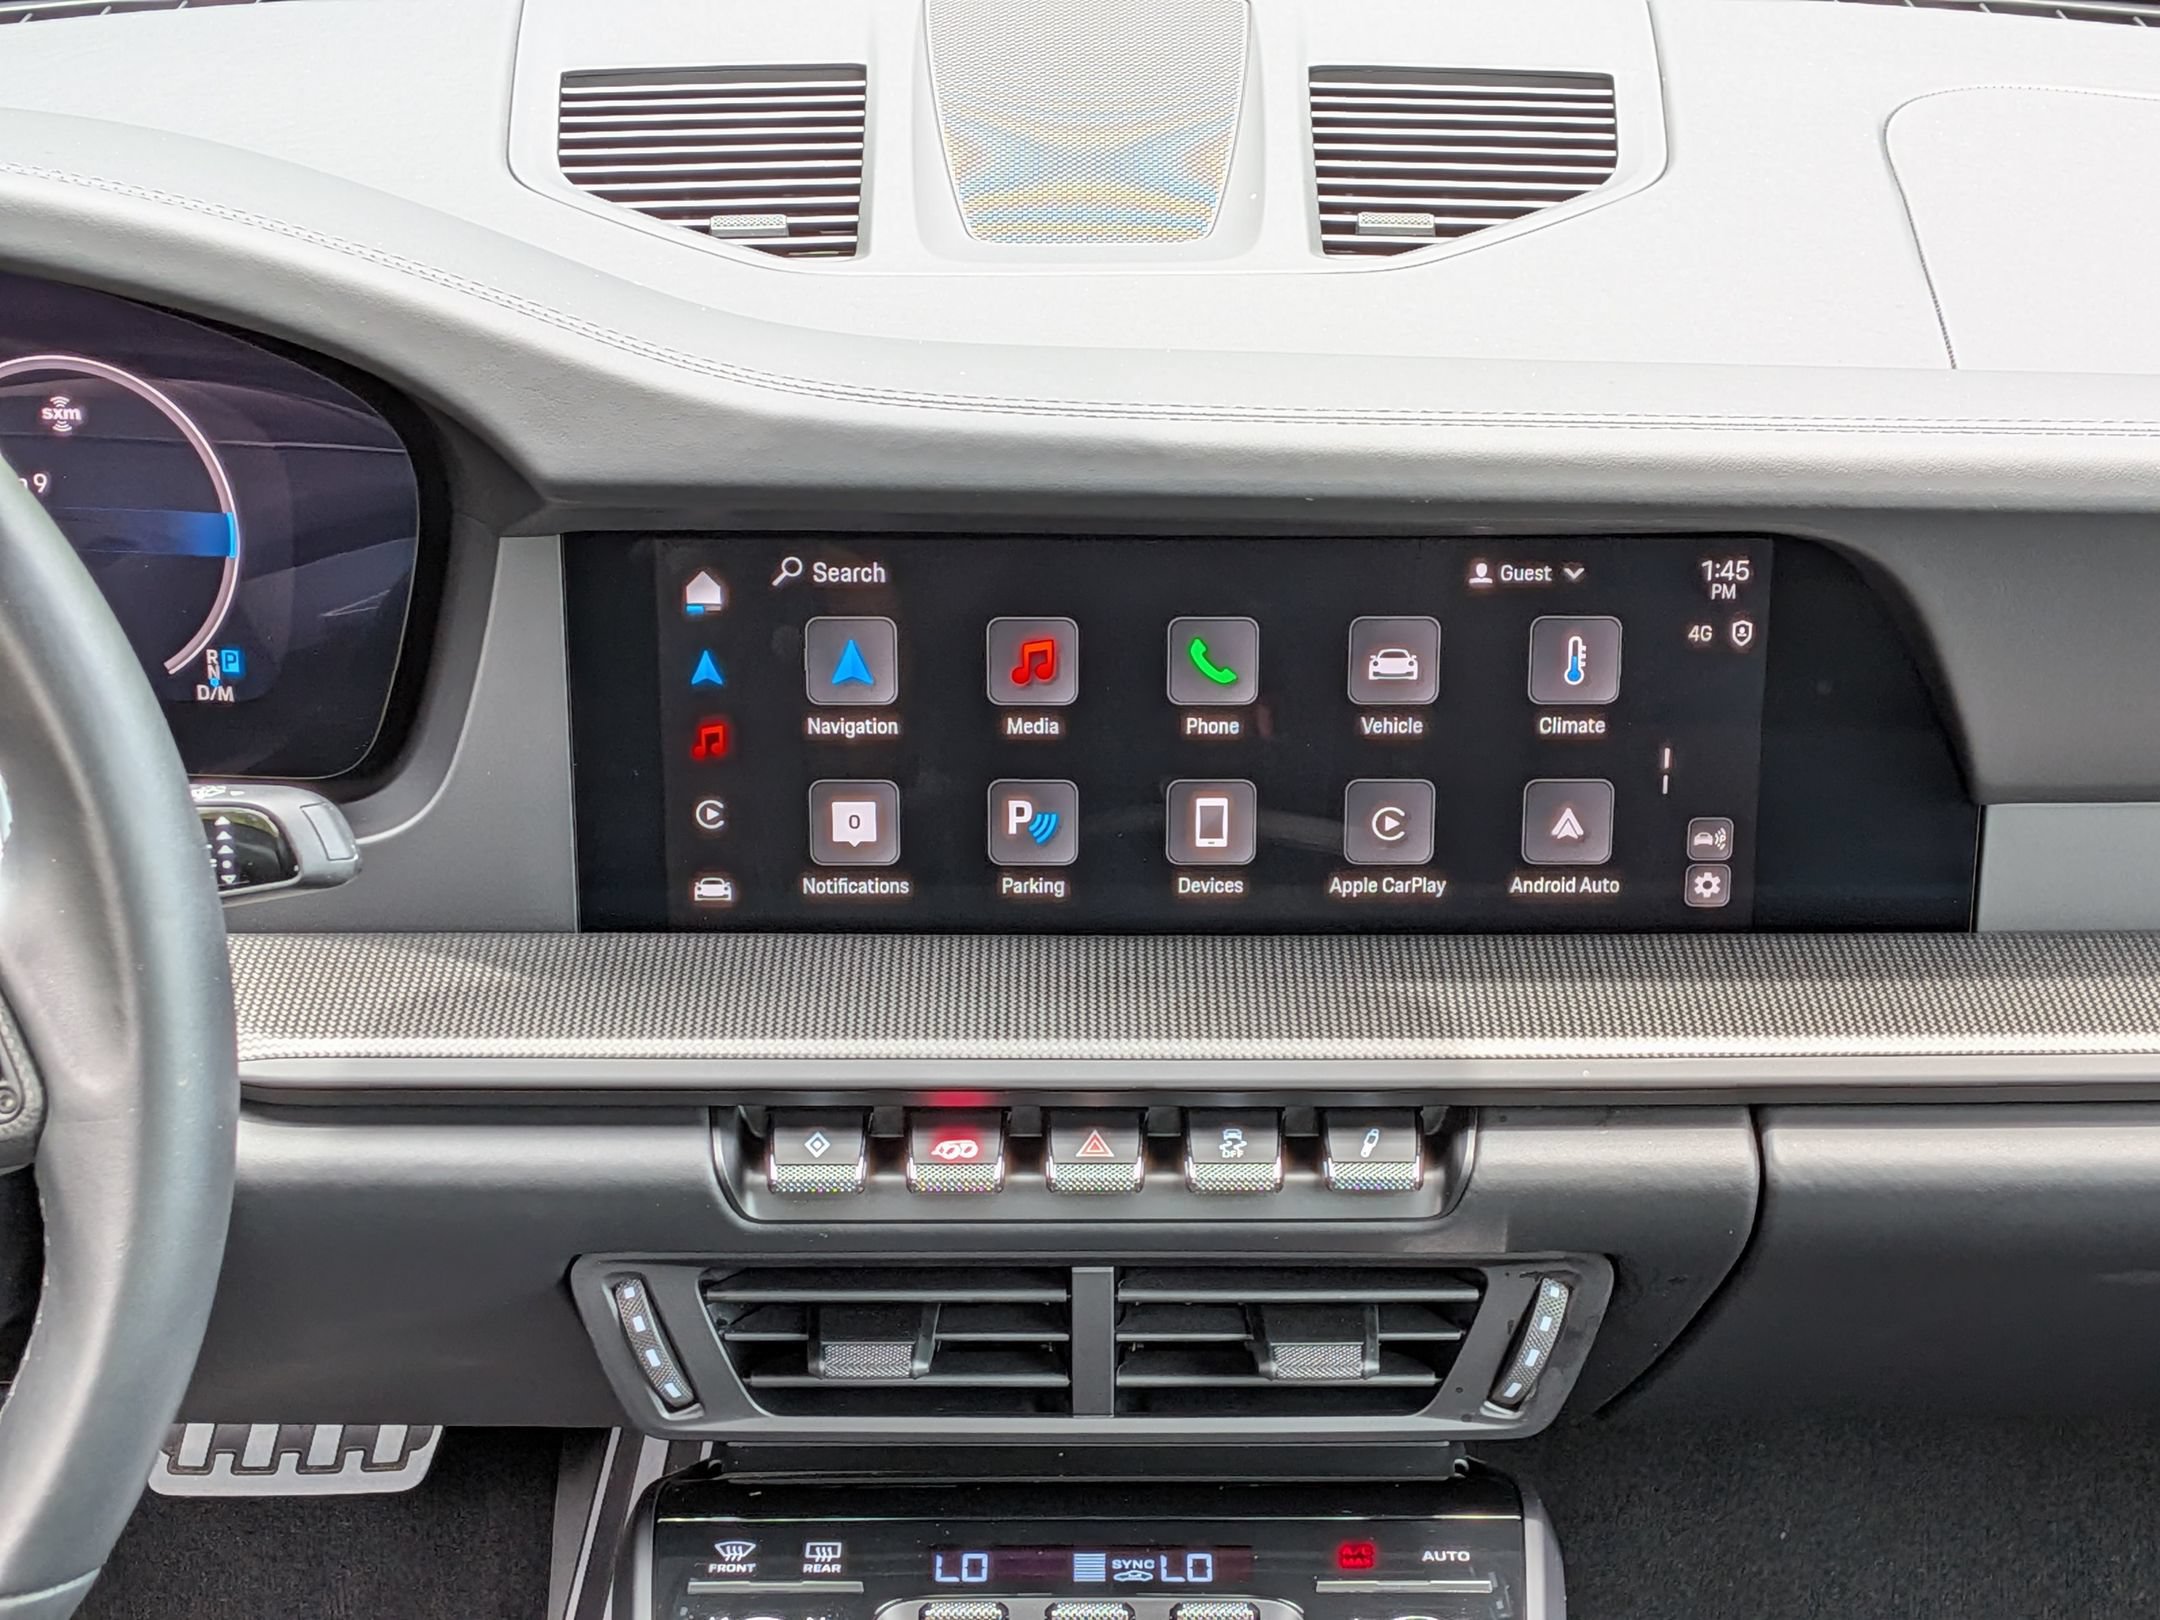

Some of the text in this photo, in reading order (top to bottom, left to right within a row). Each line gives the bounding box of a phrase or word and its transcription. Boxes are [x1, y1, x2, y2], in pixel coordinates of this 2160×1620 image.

[41, 406, 82, 420] sxm
[812, 562, 886, 583] Search
[1500, 565, 1552, 582] Guest
[1701, 560, 1750, 581] 1:45
[1711, 585, 1737, 600] PM
[1687, 625, 1713, 642] 4G
[206, 649, 218, 664] R
[208, 664, 220, 680] N
[196, 684, 235, 702] D/M
[807, 718, 899, 736] Navigation
[1006, 718, 1060, 735] Media
[1186, 718, 1240, 735] Phone
[1361, 717, 1424, 735] Vehicle
[1539, 717, 1606, 735] Climate
[802, 878, 910, 895] Notifications
[1001, 878, 1066, 897] Parking
[1178, 878, 1244, 895] Devices
[1329, 877, 1447, 897] Apple CarPlay
[1509, 876, 1621, 895] Android Auto
[1222, 1149, 1244, 1158] OFF
[1111, 1559, 1156, 1570] SYNC
[1421, 1550, 1471, 1562] AUTO
[708, 1563, 757, 1574] FRONT
[803, 1563, 842, 1574] REAR
[935, 1552, 990, 1583] LO
[1160, 1553, 1214, 1582] LO
